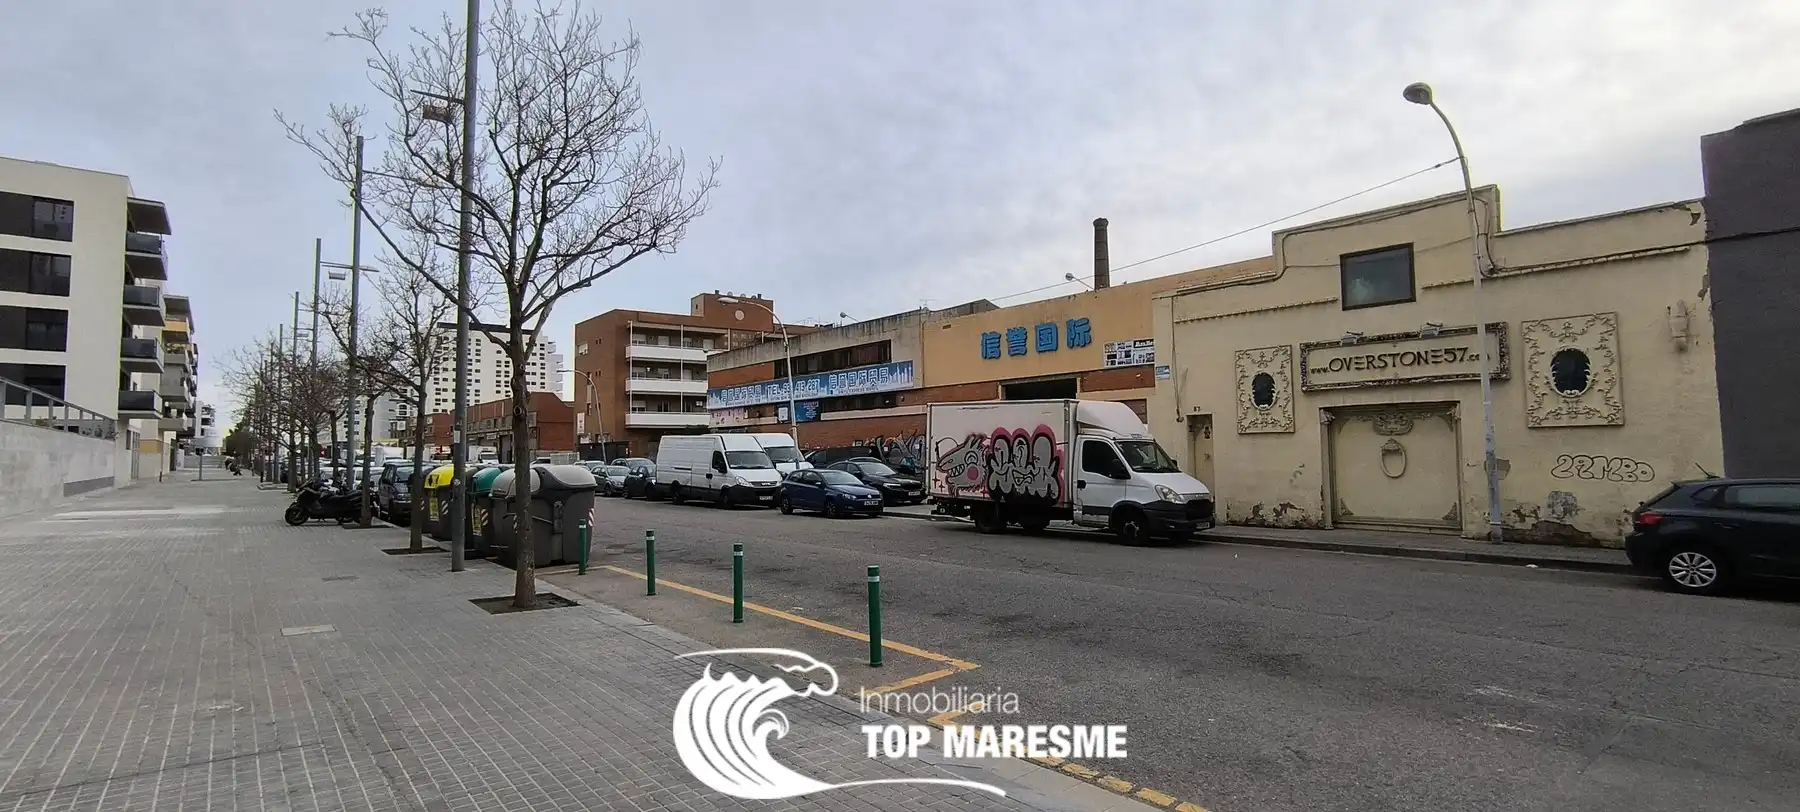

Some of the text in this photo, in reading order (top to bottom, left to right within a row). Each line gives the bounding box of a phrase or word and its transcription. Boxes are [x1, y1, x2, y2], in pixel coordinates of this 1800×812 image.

[981, 317, 1092, 360] 信誉国际
[1310, 347, 1490, 374] www.OVERSTONE57.co
